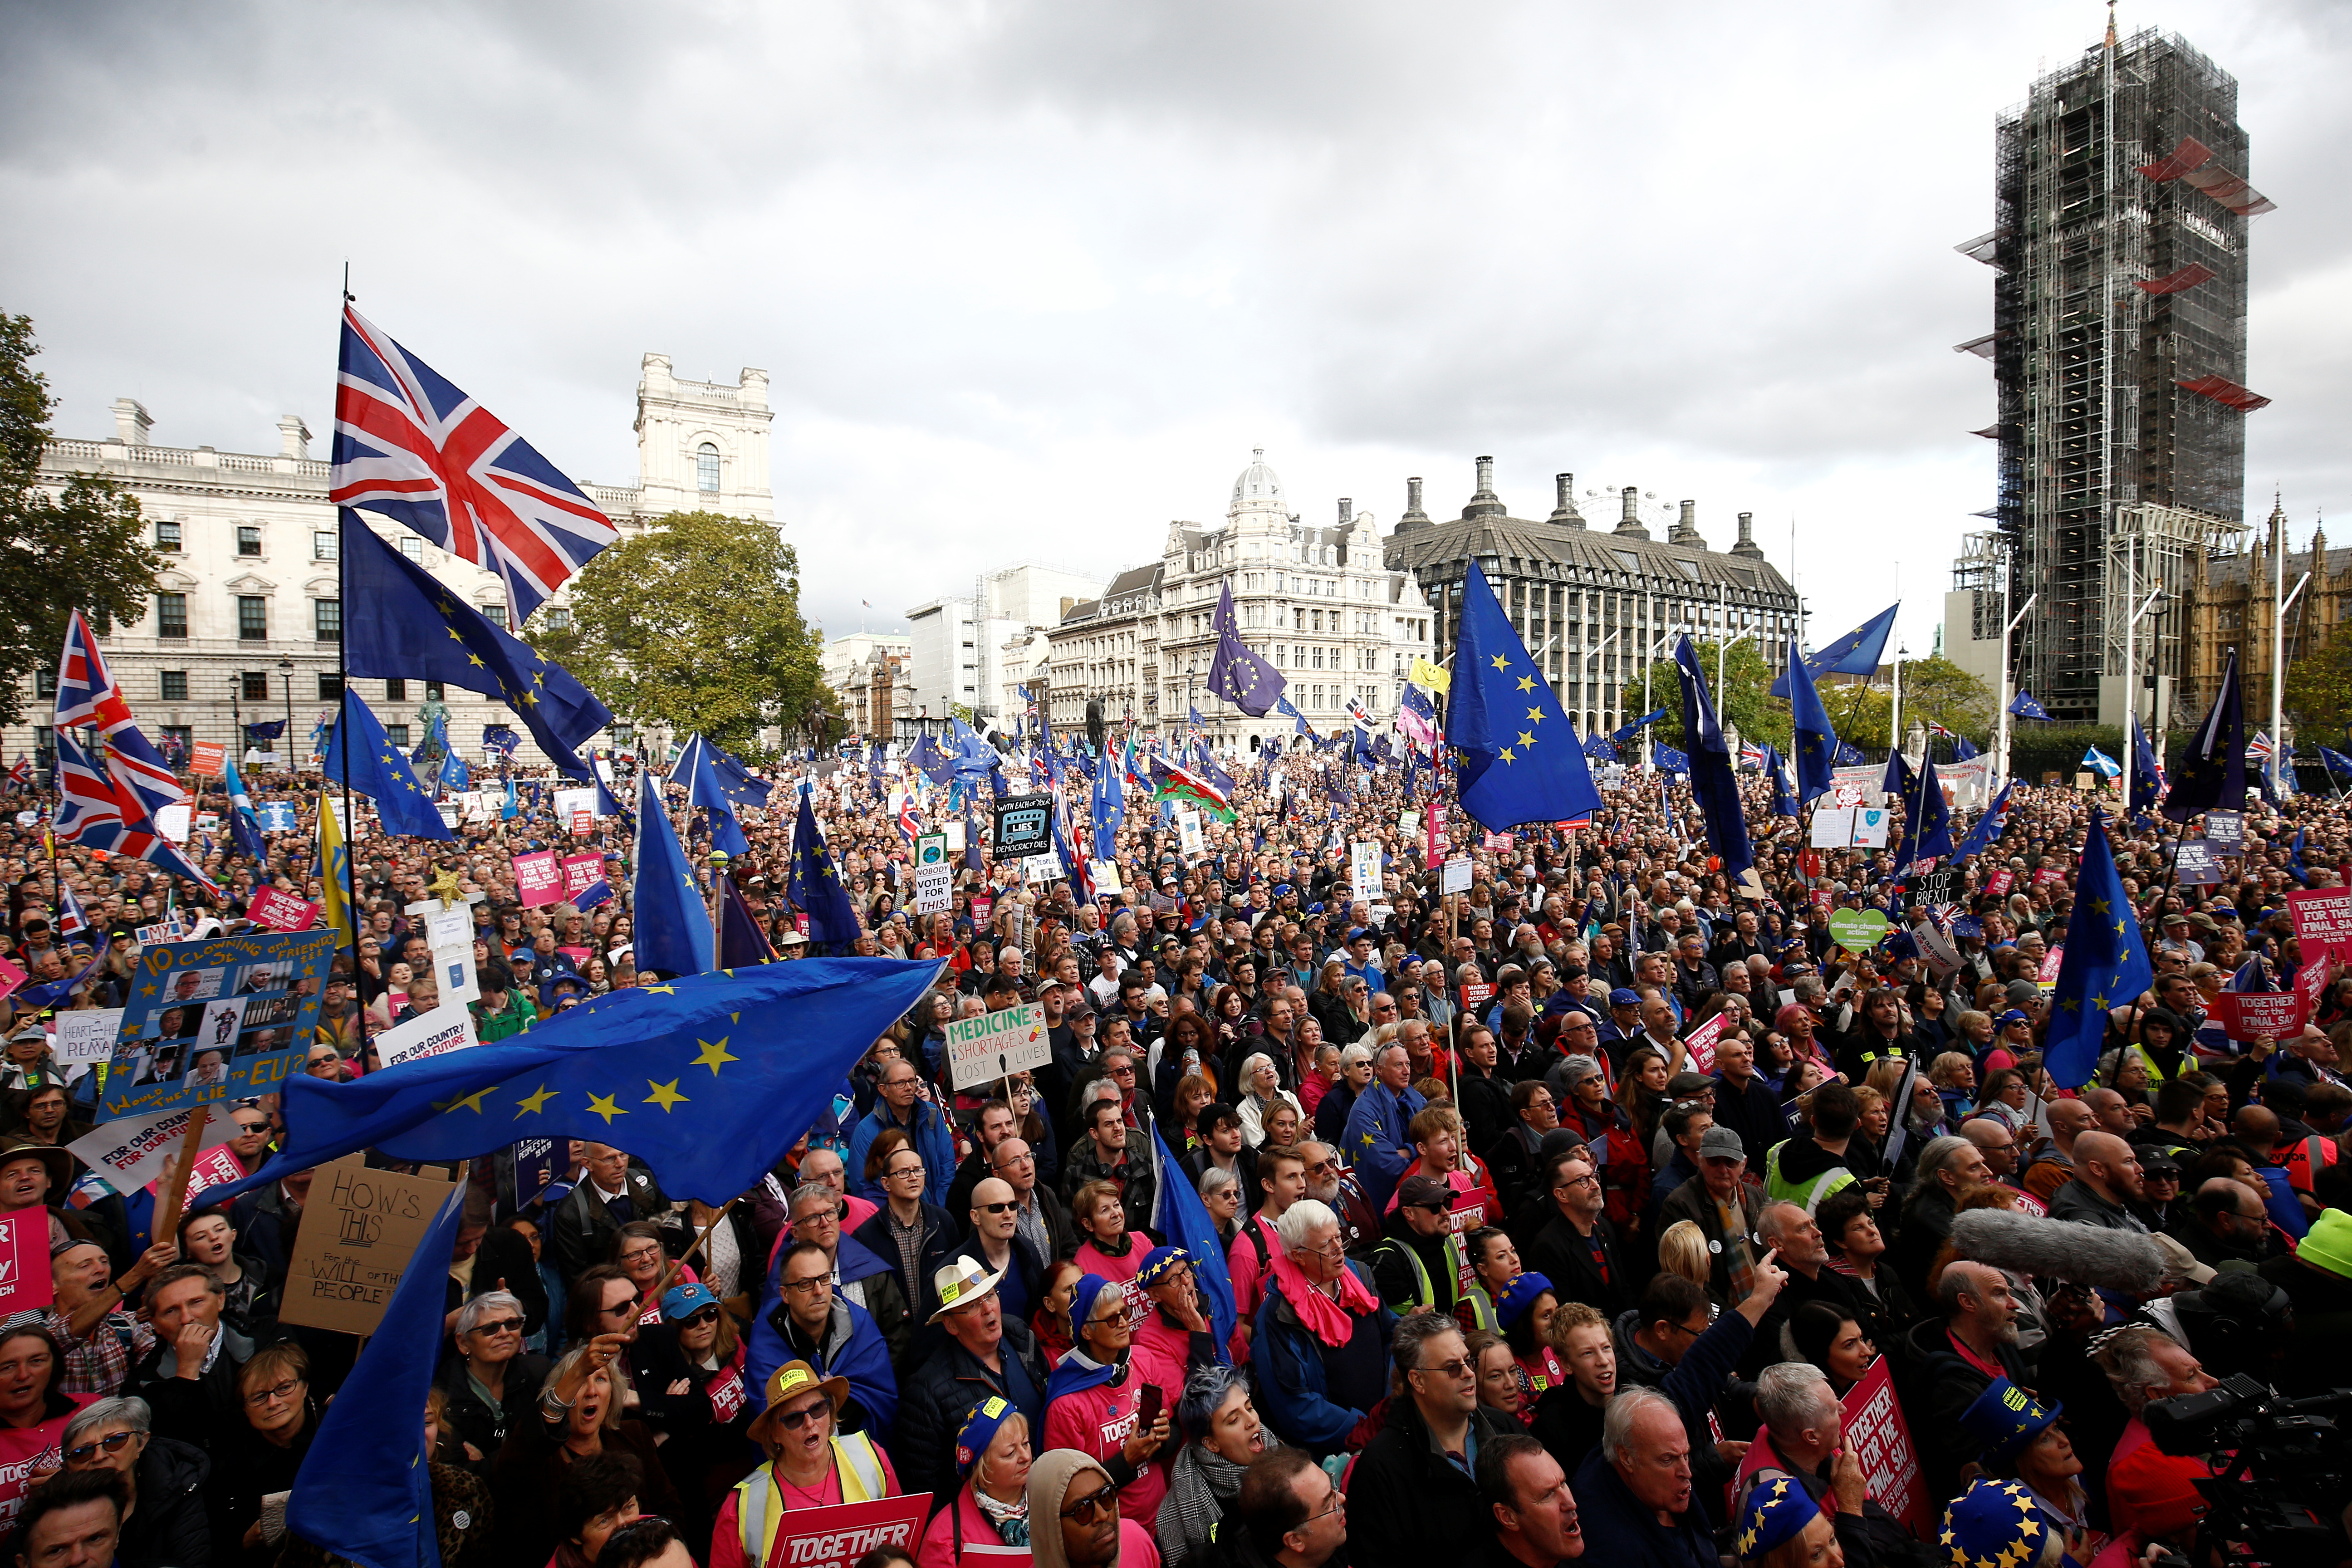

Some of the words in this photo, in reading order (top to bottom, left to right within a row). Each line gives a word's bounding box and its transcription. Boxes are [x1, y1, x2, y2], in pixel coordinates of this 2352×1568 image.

[1953, 770, 1977, 779] PARTY
[997, 803, 1014, 812] WITH
[1014, 799, 1029, 809] EACH
[1036, 798, 1051, 806] YOUR
[1012, 822, 1033, 832] LIES
[996, 842, 1034, 853] DEMOCRACY
[1034, 840, 1047, 848] DIES
[1358, 843, 1379, 853] TIME
[518, 858, 552, 870] TOGETHER
[1358, 853, 1373, 862] FOR
[523, 869, 537, 877] FOR
[537, 865, 551, 873] THE
[566, 860, 599, 872] TOGETHER
[571, 870, 585, 878] FOR
[585, 867, 598, 875] THE
[916, 865, 949, 876] NOBODY
[1359, 862, 1376, 878] EU
[522, 875, 542, 885] FINAL
[542, 872, 554, 881] SAY
[569, 876, 589, 886] FINAL
[589, 874, 603, 882] SAY
[917, 877, 949, 888] VOTED
[1919, 872, 1951, 891] STOP
[925, 887, 944, 898] FOR
[1360, 883, 1380, 895] TURN
[1916, 887, 1951, 906] BREXIT
[271, 892, 308, 912] TOGETHER
[274, 902, 285, 910] for
[285, 906, 295, 915] the
[920, 897, 949, 912] THIS!
[974, 904, 990, 912] TOGETHER
[263, 905, 285, 918] FINAL
[284, 911, 301, 923] SAY
[434, 915, 464, 925] INTERNATIONALIST
[2303, 911, 2328, 921] FOR
[2328, 908, 2352, 919] THE
[148, 924, 170, 940] MY
[440, 927, 461, 936] ISOLATIONIST
[1831, 921, 1857, 930] climate
[1858, 922, 1886, 931] change
[2301, 921, 2336, 932] FINAL
[2337, 919, 2352, 929] SA
[179, 938, 262, 966] CLOWNING
[268, 936, 291, 953] and
[277, 933, 336, 961] FRIENDS
[1915, 935, 1924, 946] FOR
[1922, 945, 1932, 956] OUR
[1929, 954, 1949, 969] FUTURE
[1918, 931, 1926, 941] FOR
[1925, 940, 1934, 951] OUR
[1933, 951, 1954, 966] COUNTRY
[143, 947, 173, 977] 10
[210, 952, 238, 966] St.
[2043, 954, 2058, 977] TOGETHER
[2302, 955, 2326, 980] TOGETHER
[2239, 996, 2295, 1008] TOGETHER
[949, 1007, 1032, 1044] MEDICINE
[2242, 1016, 2276, 1027] FINAL
[2278, 1014, 2296, 1025] SAY
[64, 1025, 93, 1039] HEART
[103, 1023, 118, 1037] HE
[1691, 1023, 1720, 1049] TOGETHER
[67, 1040, 115, 1057] REMAI
[389, 1051, 409, 1066] FOR
[409, 1041, 426, 1056] OUR
[426, 1022, 464, 1047] COUNTRY
[432, 1033, 467, 1056] FUTURE
[958, 1029, 1024, 1061] SHORTAGES
[1702, 1042, 1710, 1052] for
[1708, 1036, 1718, 1045] the
[956, 1060, 987, 1082] COST
[1015, 1045, 1046, 1065] LIVES
[106, 1088, 163, 1115] WOULD
[150, 1088, 190, 1107] THEY
[196, 1084, 228, 1102] LIE
[230, 1070, 245, 1080] TO
[250, 1054, 305, 1086] EU?
[101, 1145, 132, 1165] FOR
[129, 1127, 158, 1148] OUR
[156, 1109, 193, 1131] COUNT
[115, 1150, 146, 1171] FOR
[142, 1133, 171, 1152] OUR
[519, 1139, 540, 1161] PEOPLE'S
[535, 1141, 552, 1158] 19.10.19
[331, 1169, 421, 1218] HOW'S
[338, 1207, 383, 1243] THIS
[323, 1252, 341, 1262] For
[344, 1255, 361, 1266] the
[367, 1272, 381, 1280] OF
[382, 1272, 402, 1284] TH
[941, 1283, 956, 1294] BOLLOCKS
[946, 1286, 957, 1295] BREXIT
[1127, 1296, 1139, 1306] for
[782, 1370, 804, 1380] BOLLOCKS
[729, 1400, 739, 1414] for
[984, 1397, 996, 1412] BOLLOCKS
[991, 1399, 1000, 1410] BREXIT
[1848, 1386, 1894, 1450] TOGETHER
[1861, 1436, 1883, 1475] FOR
[1878, 1413, 1899, 1450] THE
[1866, 1460, 1895, 1499] FINAL
[1891, 1435, 1907, 1472] SAY
[1893, 1477, 1906, 1499] VOTE
[1902, 1460, 1917, 1486] MARCH
[1892, 1492, 1910, 1519] 19.10.19
[789, 1523, 909, 1564] TOGETHER
